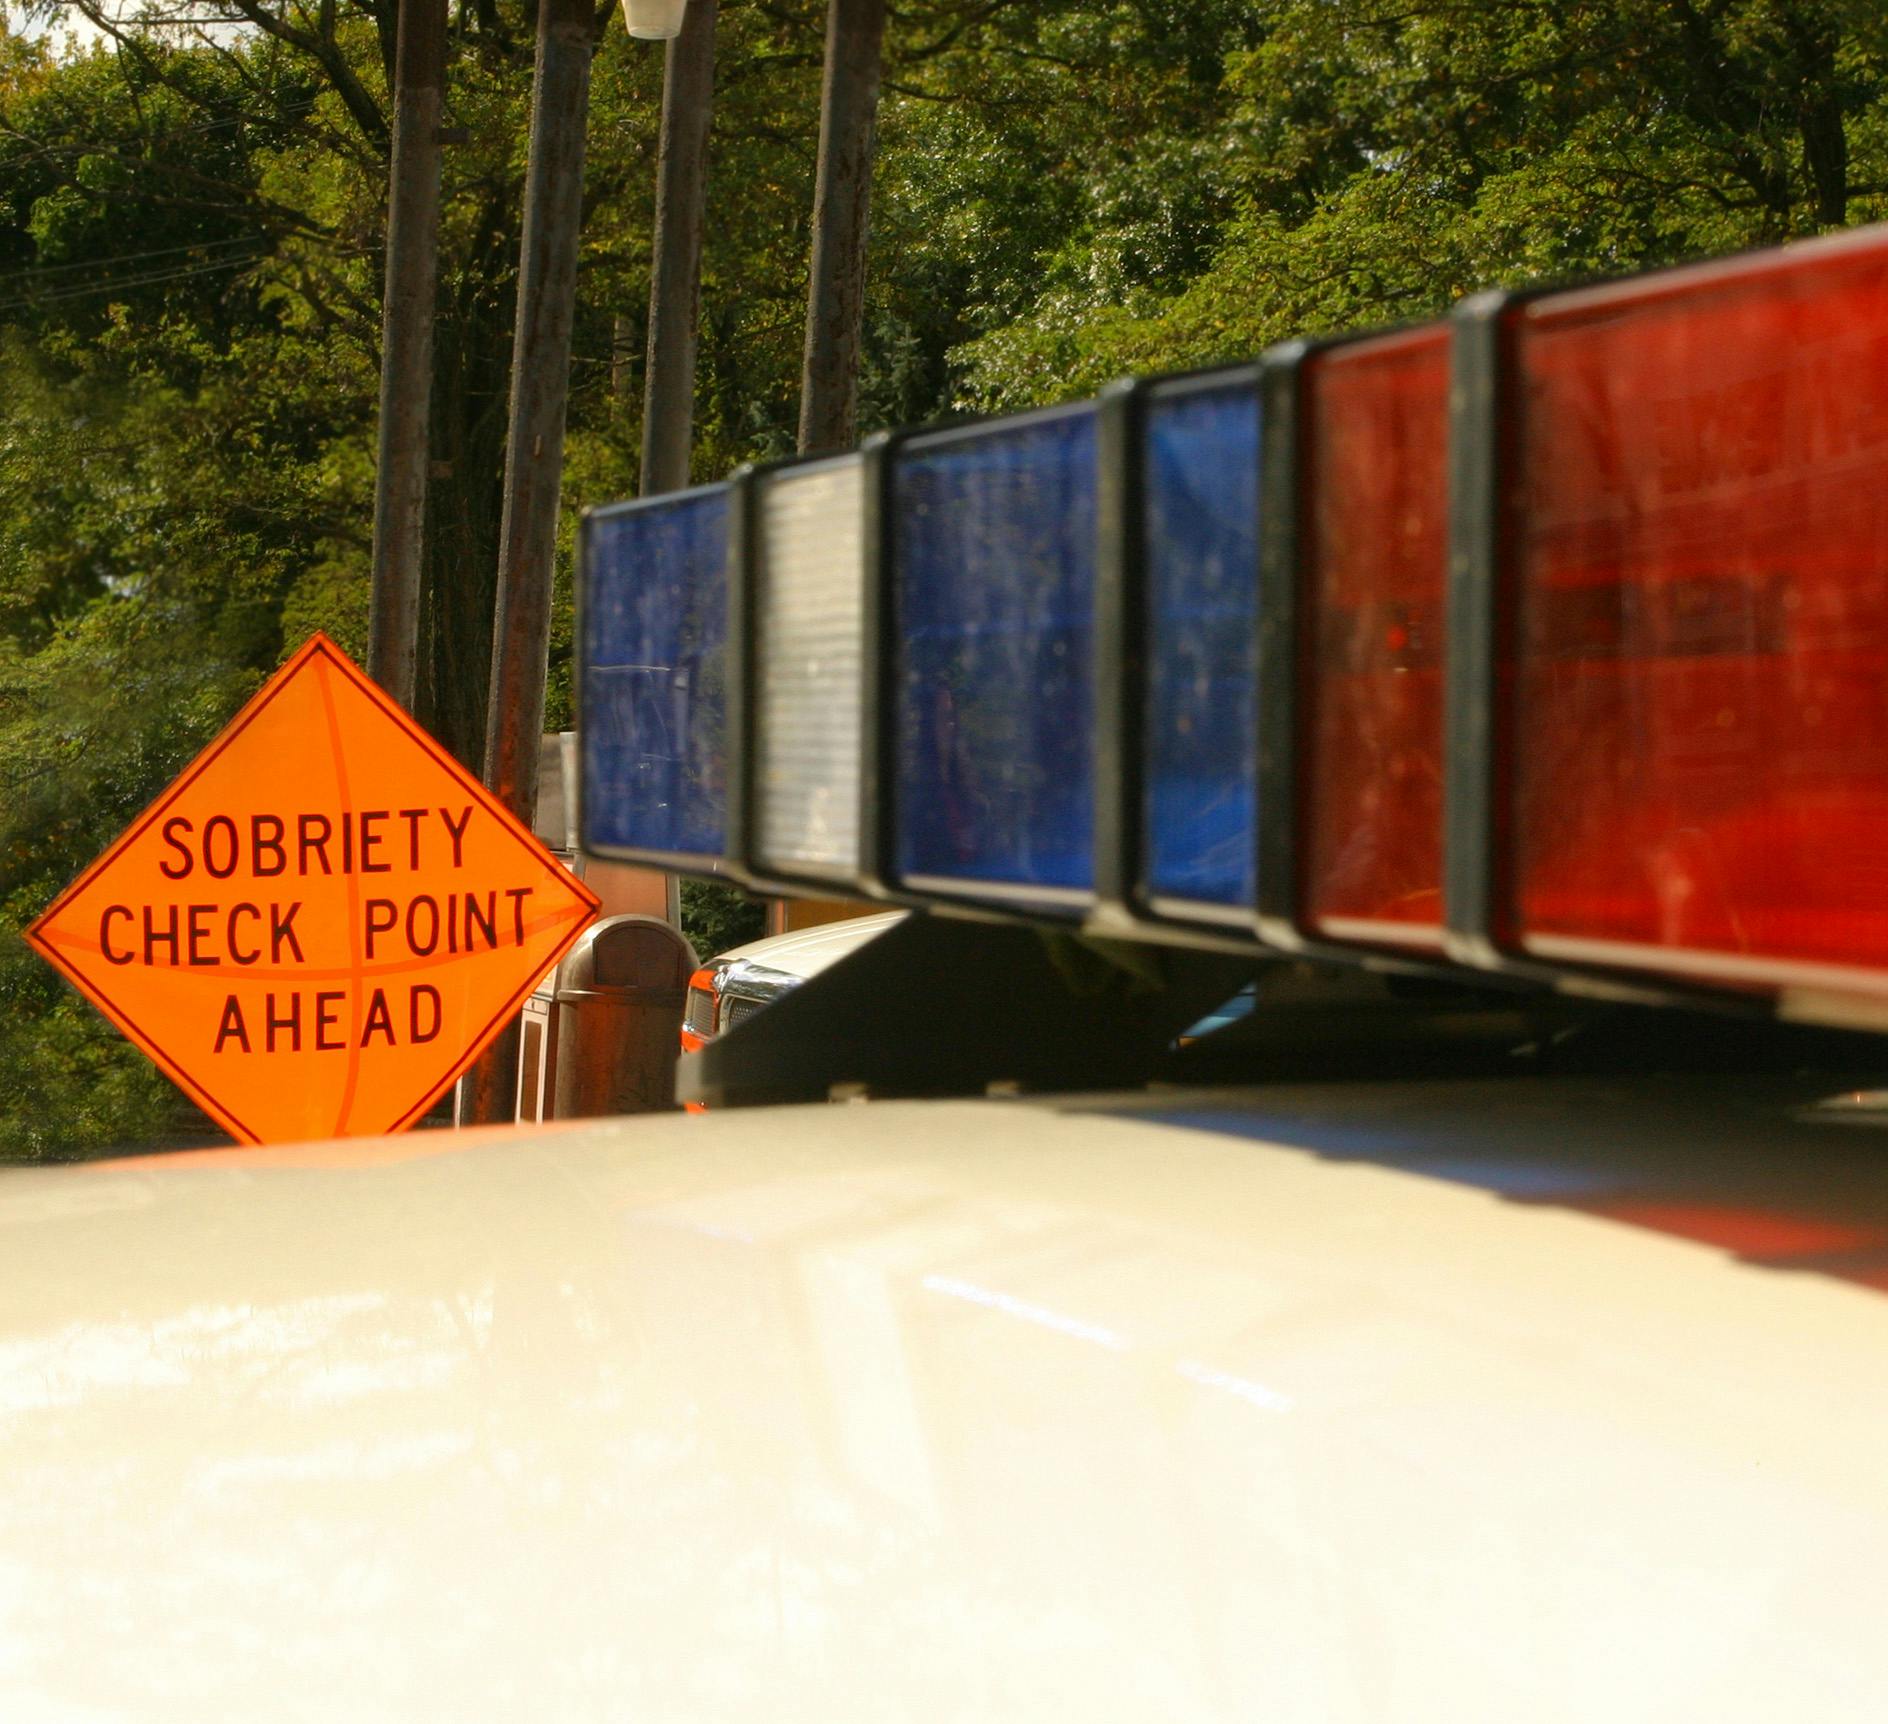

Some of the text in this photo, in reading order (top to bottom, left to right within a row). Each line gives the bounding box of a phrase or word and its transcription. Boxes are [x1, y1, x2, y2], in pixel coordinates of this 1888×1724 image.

[159, 806, 474, 880] SOBRIETY
[100, 887, 533, 967] CHECK POINT
[213, 984, 443, 1054] AHEAD
